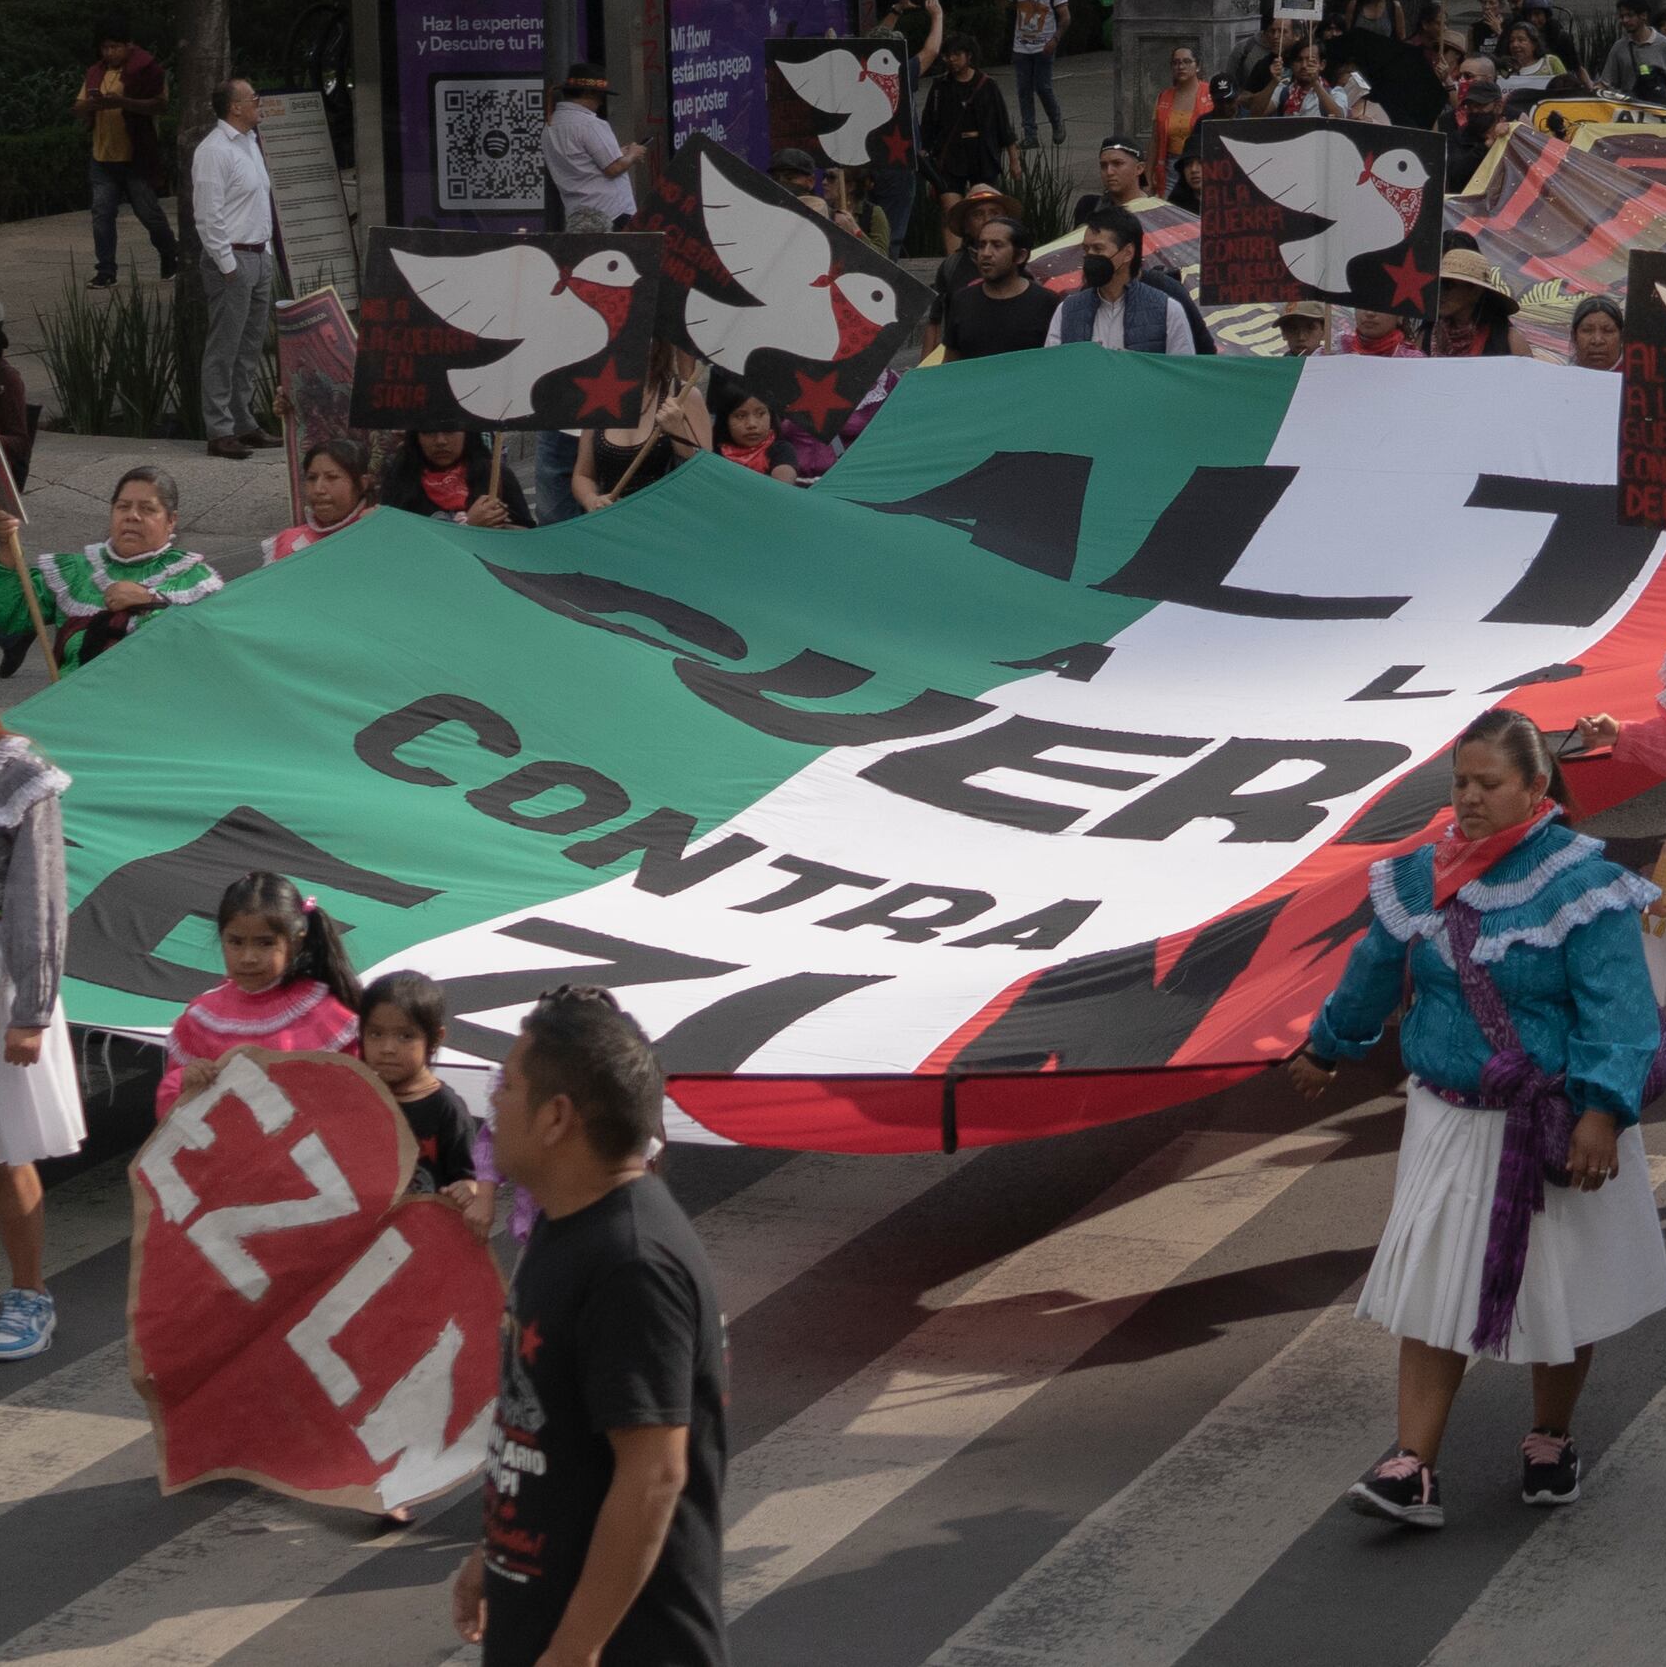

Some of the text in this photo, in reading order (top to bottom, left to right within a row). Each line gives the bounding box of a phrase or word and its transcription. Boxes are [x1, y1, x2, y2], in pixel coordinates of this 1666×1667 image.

[422, 16, 453, 32] Haz
[455, 15, 470, 32] la
[417, 39, 426, 56] y
[430, 35, 505, 52] Descubre
[507, 36, 524, 51] tu
[670, 25, 711, 53] Mi flow
[672, 54, 752, 85] está más pegao
[673, 88, 729, 118] que póster
[1203, 159, 1233, 182] NO
[1204, 184, 1251, 208] A LA
[1202, 204, 1284, 234] GUERRA
[1202, 236, 1277, 264] CONTRA
[1218, 283, 1303, 303] MAPUCHE
[361, 296, 410, 321] NO A
[384, 354, 414, 382] EN
[370, 382, 429, 410] SIRIA
[1626, 385, 1649, 418] A
[354, 691, 1104, 954] CONTRA
